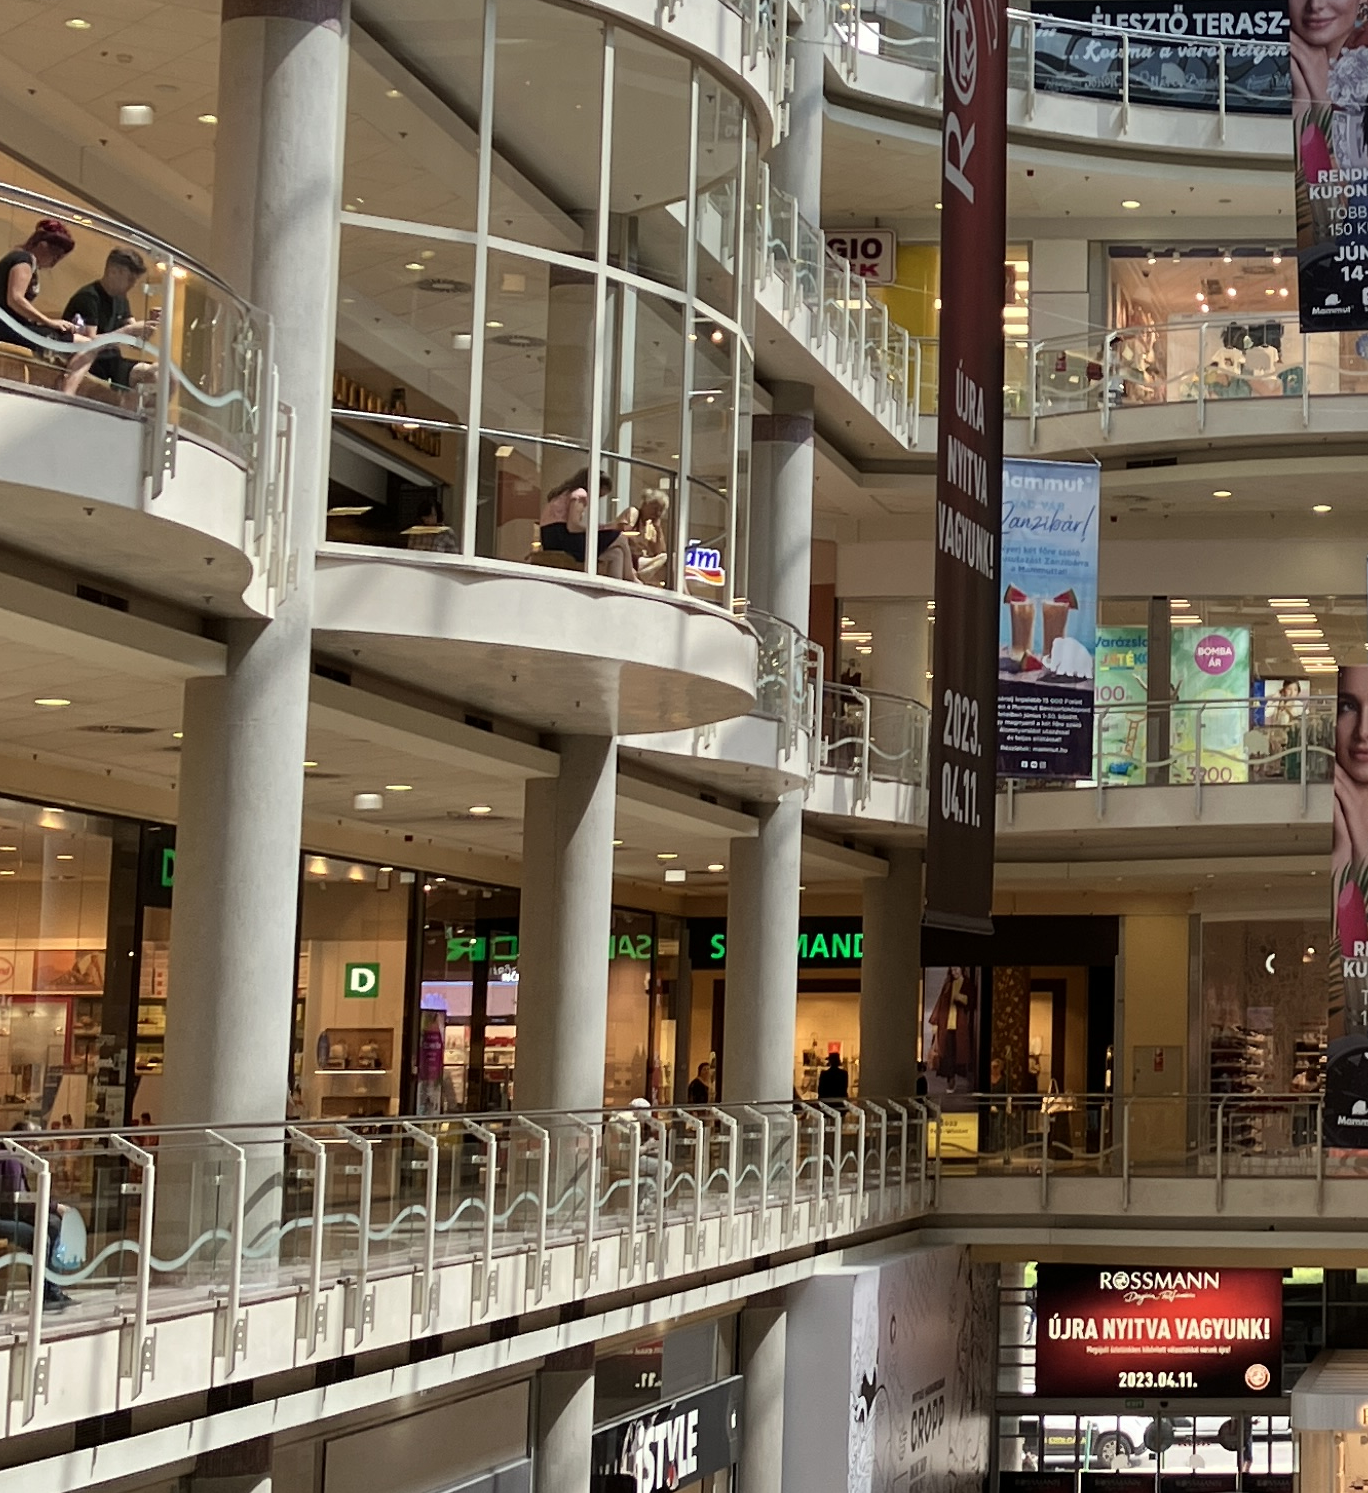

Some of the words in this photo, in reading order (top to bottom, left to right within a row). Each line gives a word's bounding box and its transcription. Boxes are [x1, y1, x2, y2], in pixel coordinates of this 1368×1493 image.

[1091, 5, 1189, 36] ÉLESZTŐ
[1193, 11, 1290, 35] TERASZ-
[1329, 224, 1352, 236] 150
[827, 237, 883, 260] GIO
[956, 359, 985, 435] ÚJRA
[947, 434, 988, 508] NYITVA
[938, 500, 994, 580] VAGYUNK!
[1198, 647, 1233, 656] BOMBA
[1208, 657, 1222, 668] ÁR
[943, 688, 982, 757] 2023.
[941, 761, 980, 828] 04.11.
[1100, 1271, 1220, 1290] ROSSMANN
[1048, 1313, 1098, 1340] ÚJRA
[1102, 1317, 1171, 1340] NYITVA
[1175, 1317, 1270, 1340] VAGYUNK!
[1118, 1372, 1198, 1389] 2023.04.11.
[911, 1395, 944, 1452] CROPP
